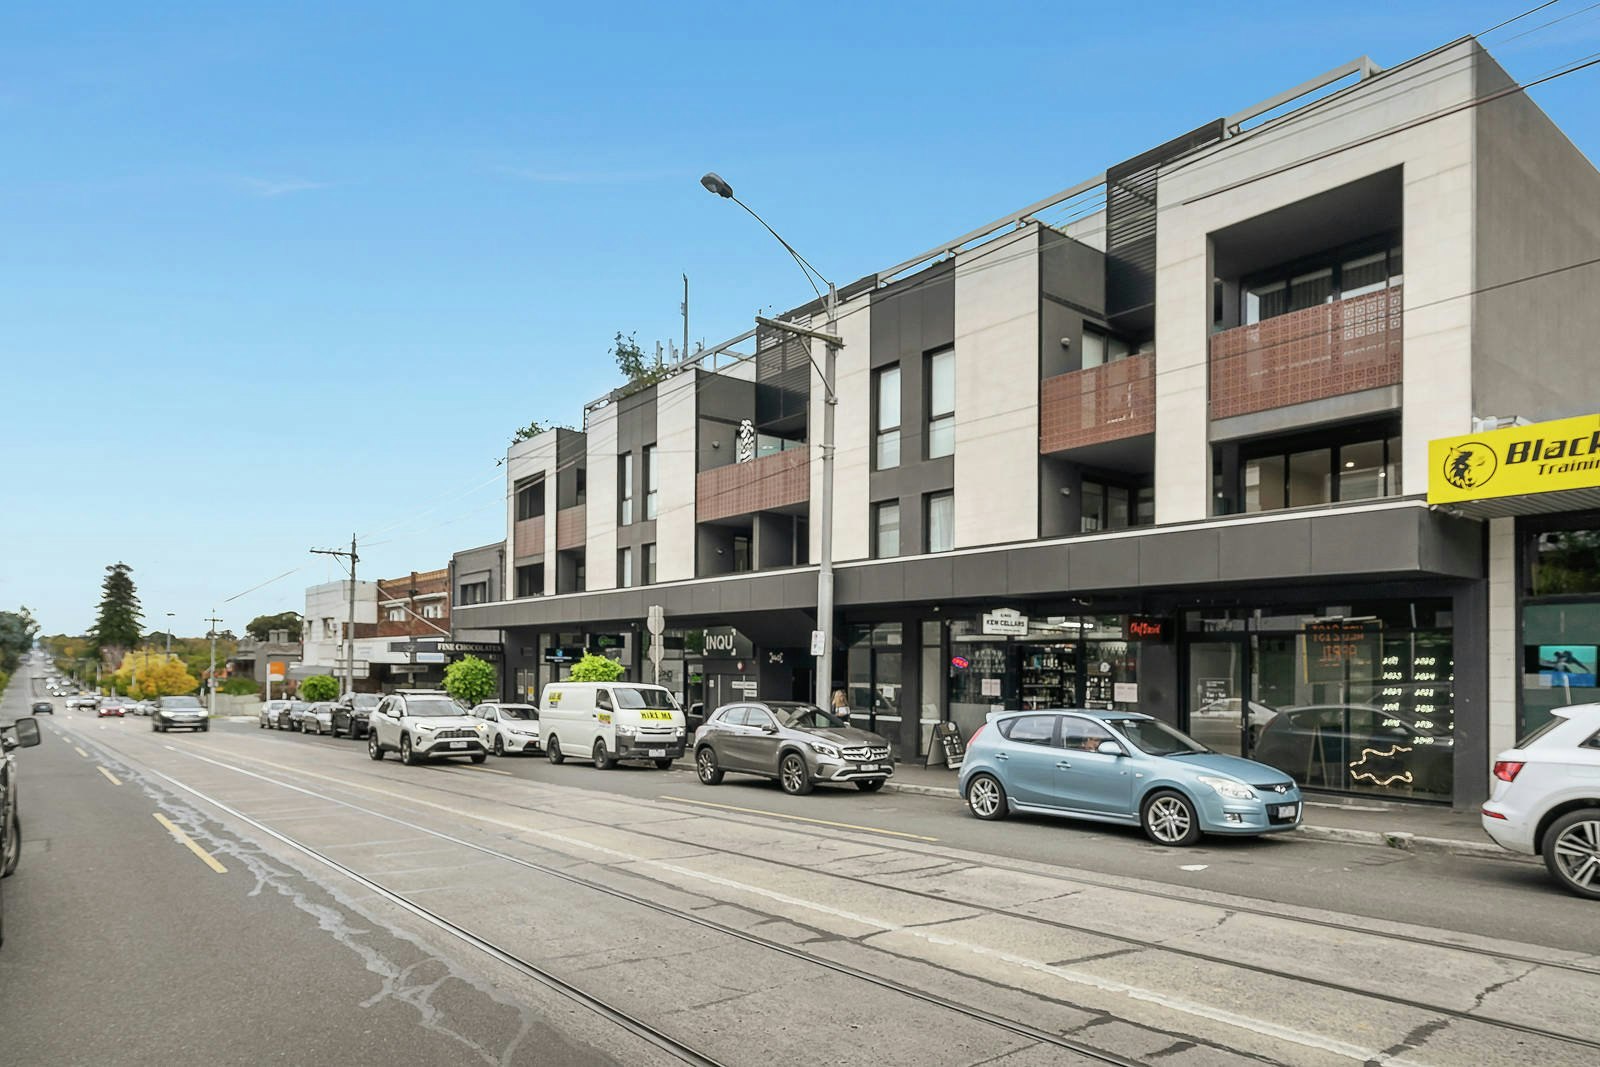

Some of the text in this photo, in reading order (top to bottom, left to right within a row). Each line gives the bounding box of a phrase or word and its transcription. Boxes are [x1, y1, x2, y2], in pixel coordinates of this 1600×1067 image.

[437, 642, 501, 651] FINE CHOCOLATES
[706, 635, 733, 650] INQU
[641, 711, 659, 719] HIRE
